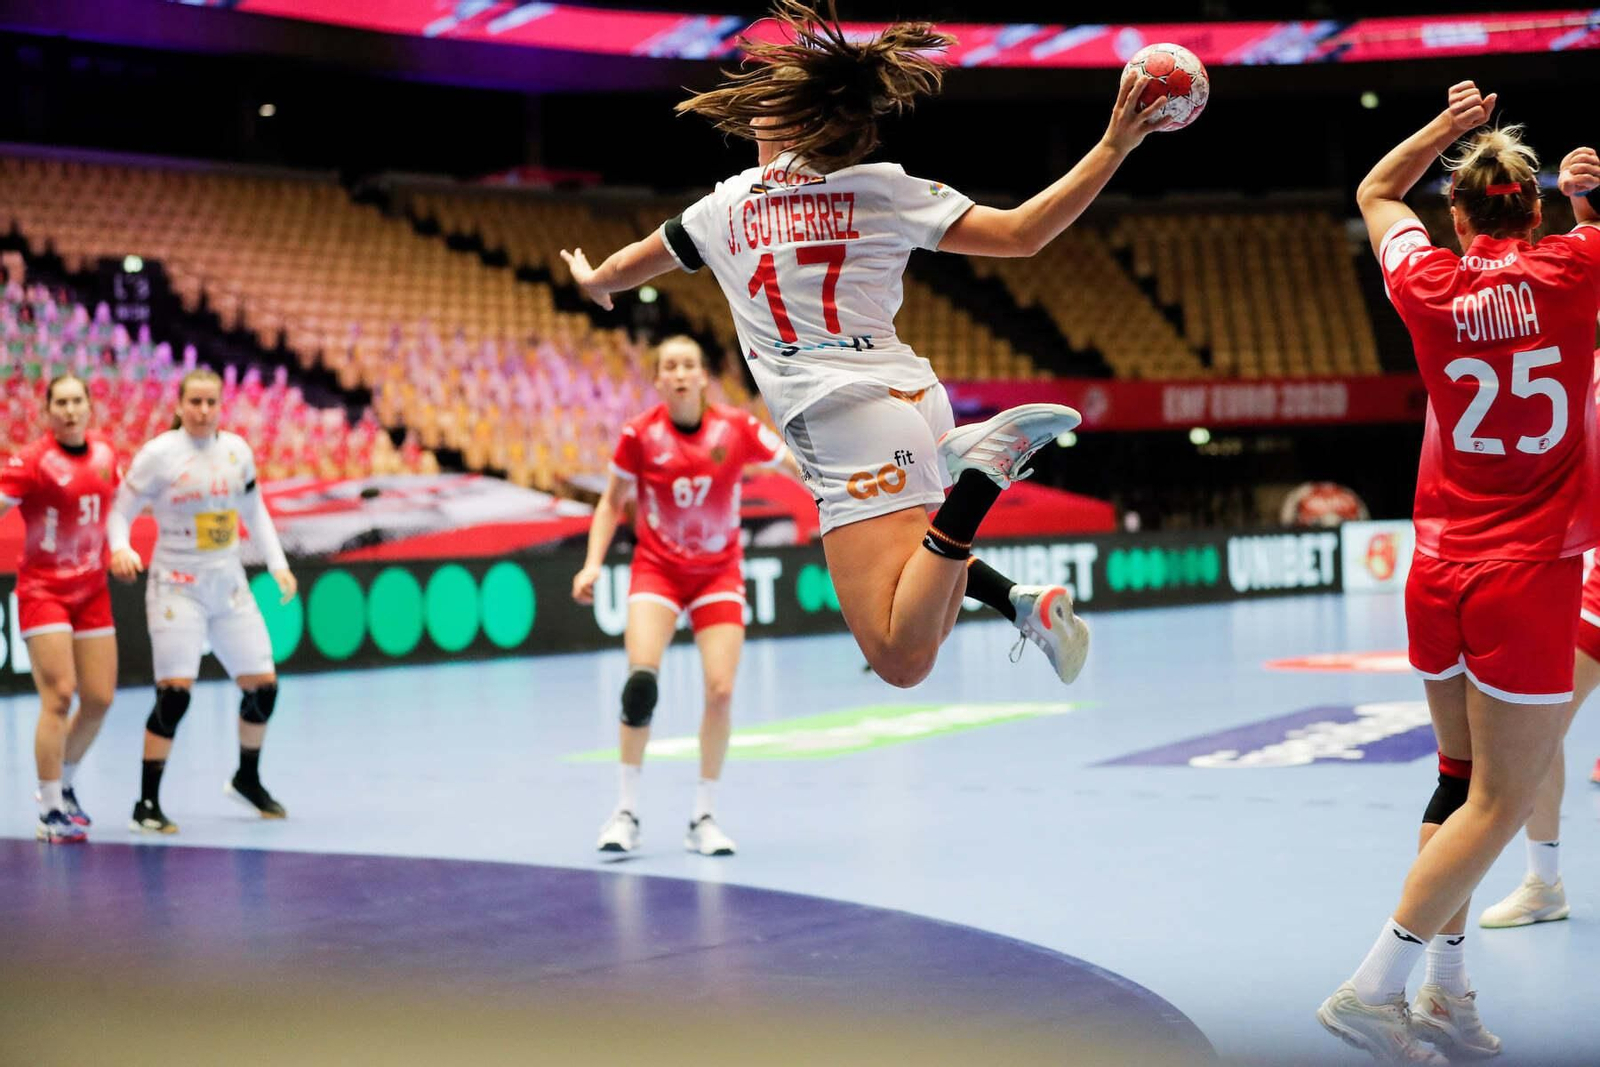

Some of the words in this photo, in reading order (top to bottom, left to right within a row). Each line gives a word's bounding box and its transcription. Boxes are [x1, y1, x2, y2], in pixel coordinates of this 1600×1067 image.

[728, 205, 742, 256] J.
[743, 187, 860, 250] GUTIÉRREZ
[748, 244, 847, 344] 17
[1452, 281, 1541, 343] FOMINA
[1443, 345, 1568, 456] 25
[672, 476, 713, 509] 67
[846, 463, 907, 501] GO
[893, 449, 916, 468] fit
[78, 494, 101, 526] 51
[1227, 532, 1338, 593] UNIBET
